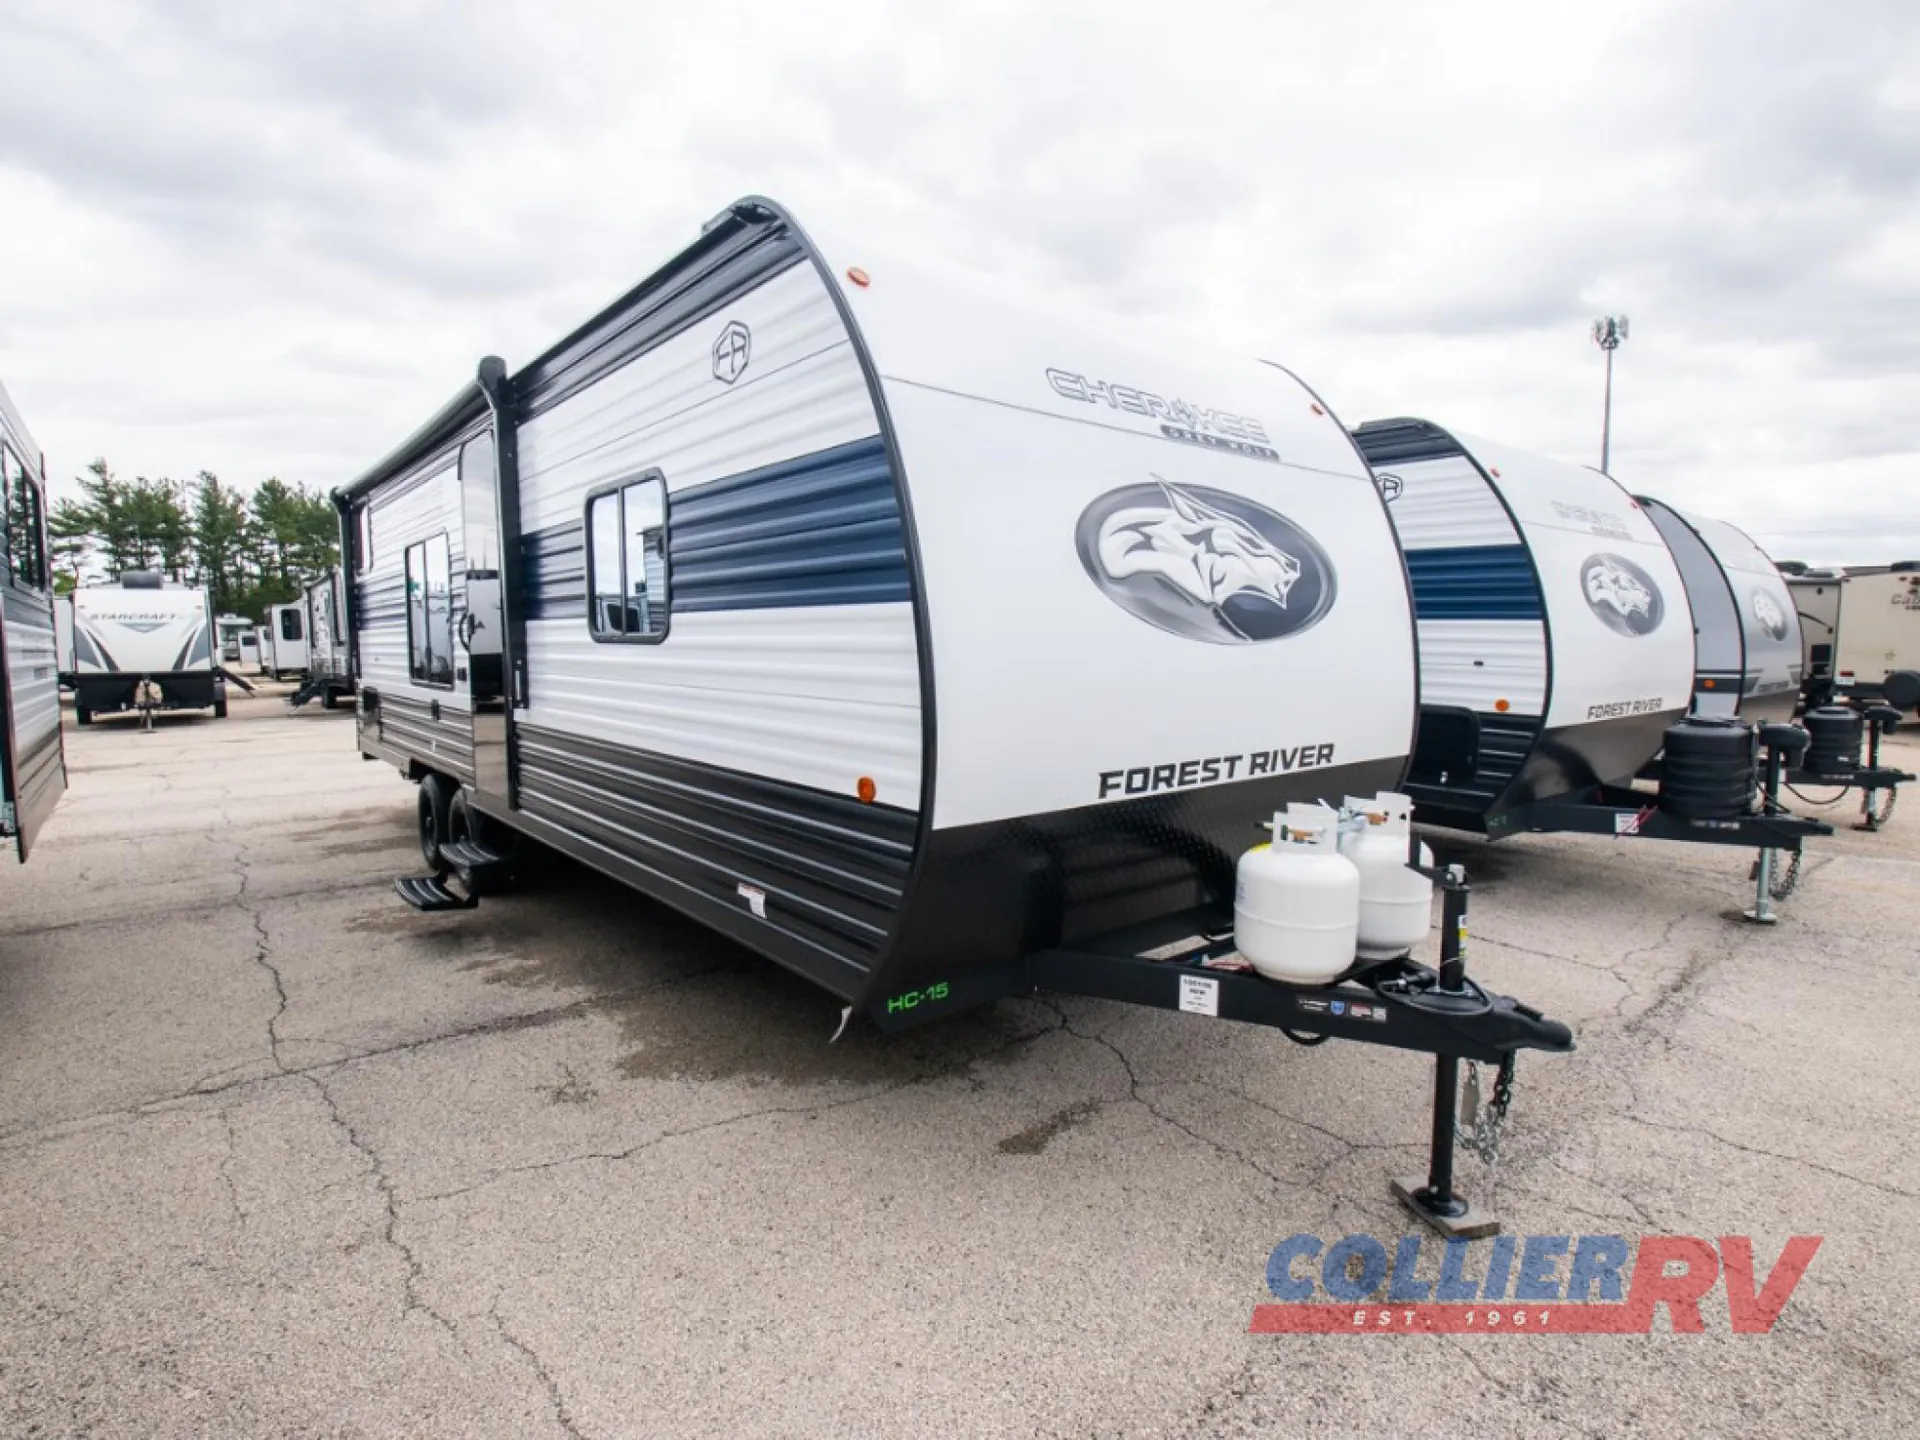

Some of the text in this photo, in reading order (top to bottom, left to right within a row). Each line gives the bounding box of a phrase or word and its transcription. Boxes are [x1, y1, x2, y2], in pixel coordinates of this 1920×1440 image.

[1098, 743, 1335, 800] FOREST RIVER
[887, 982, 949, 1014] HC-15
